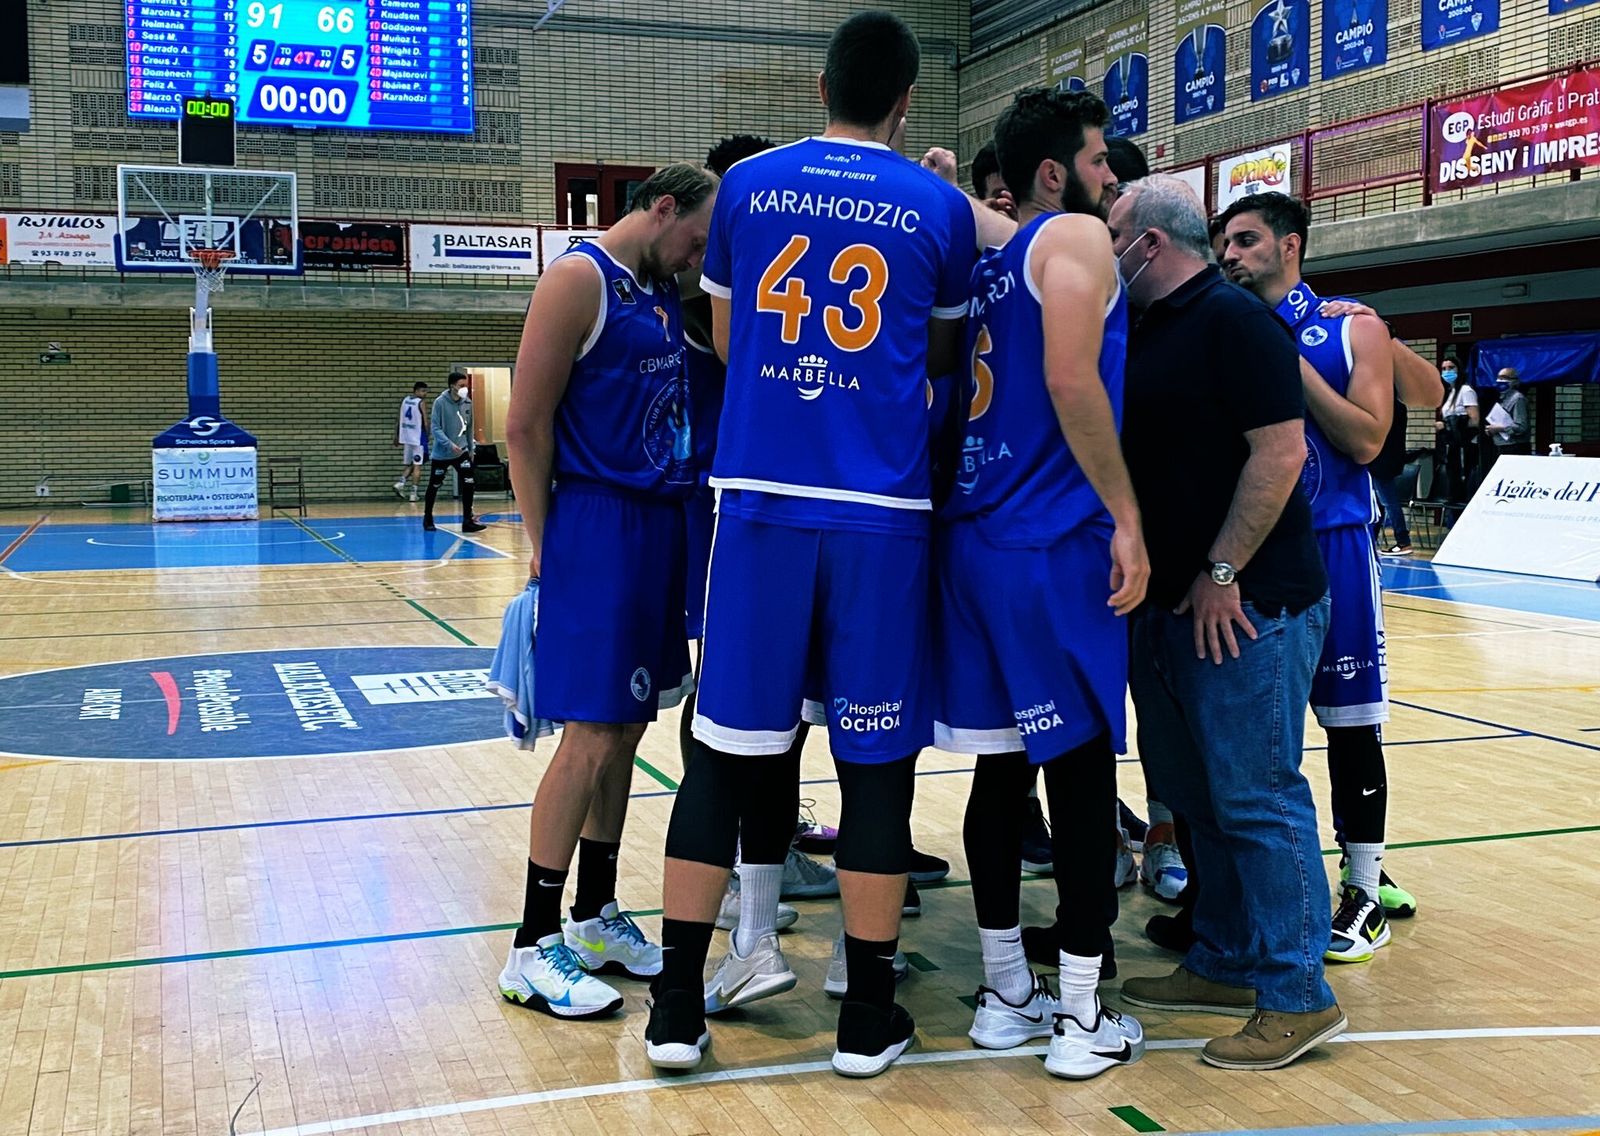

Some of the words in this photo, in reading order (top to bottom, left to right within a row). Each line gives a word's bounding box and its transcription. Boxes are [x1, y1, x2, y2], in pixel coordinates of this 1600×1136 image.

[128, 6, 134, 15] 5
[224, 12, 233, 21] 11
[381, 0, 420, 9] Cameron
[456, 3, 467, 12] 12
[247, 2, 283, 29] 91
[317, 6, 354, 33] 66
[369, 9, 375, 18] 7
[381, 10, 420, 20] Knudsen
[461, 14, 467, 23] 7
[128, 17, 135, 27] 7
[228, 24, 235, 33] 7
[370, 22, 380, 30] 10
[381, 22, 427, 33] Godspowe
[462, 27, 467, 36] 2
[1335, 19, 1373, 44] CAMPIÓ
[228, 36, 235, 45] 3
[370, 33, 380, 42] 11
[457, 38, 467, 47] 10
[129, 42, 141, 52] 10
[142, 43, 178, 54] Parrado
[181, 45, 191, 54] A.
[224, 48, 235, 57] 14
[252, 44, 267, 64] 5
[280, 47, 291, 55] TO
[321, 49, 332, 57] TO
[341, 49, 355, 69] 5
[370, 45, 381, 54] 12
[382, 46, 411, 58] Wright
[413, 47, 422, 56] D.
[130, 55, 140, 64] 11
[142, 55, 170, 65] Creus
[229, 60, 235, 69] 3
[383, 57, 411, 67] Tamba
[382, 69, 428, 80] Majstorovi
[1185, 71, 1215, 93] CAMPIÓ
[143, 79, 165, 89] Feliz
[167, 80, 177, 90] A.
[463, 85, 468, 94] 5
[143, 91, 172, 102] Marzo
[260, 84, 346, 115] 00:00
[383, 92, 428, 103] Karahodzi
[463, 96, 469, 106] 2
[187, 101, 229, 117] 00:00
[1112, 96, 1139, 115] CAMPIÓ
[1448, 120, 1469, 135] EGP
[1477, 108, 1515, 130] Estudi
[1518, 98, 1553, 120] Gràfic
[1568, 87, 1600, 110] Prat
[1521, 127, 1530, 136] 70
[801, 165, 841, 178] SIEMPRE
[842, 171, 877, 181] FUERTE
[1439, 148, 1518, 183] DISSENY
[749, 189, 921, 234] KARAHODZIC
[444, 234, 532, 249] BALTASAR
[155, 250, 179, 258] PRAT
[757, 234, 889, 352] 43
[760, 364, 860, 390] MARBELLA
[405, 406, 413, 421] 4
[158, 467, 254, 480] SUMMUM
[187, 481, 220, 489] SALUT
[1486, 478, 1551, 499] Aigües
[1554, 481, 1589, 502] del
[157, 494, 205, 502] FISIOTERAPIA
[272, 661, 328, 683] MAIL
[1322, 660, 1374, 673] MARBELLA
[284, 681, 345, 709] BOXES
[78, 688, 123, 720] AIRPORT
[849, 700, 902, 715] Hospital
[1014, 699, 1056, 720] ospital
[840, 715, 901, 732] OCHOA
[1018, 713, 1064, 736] CHOA
